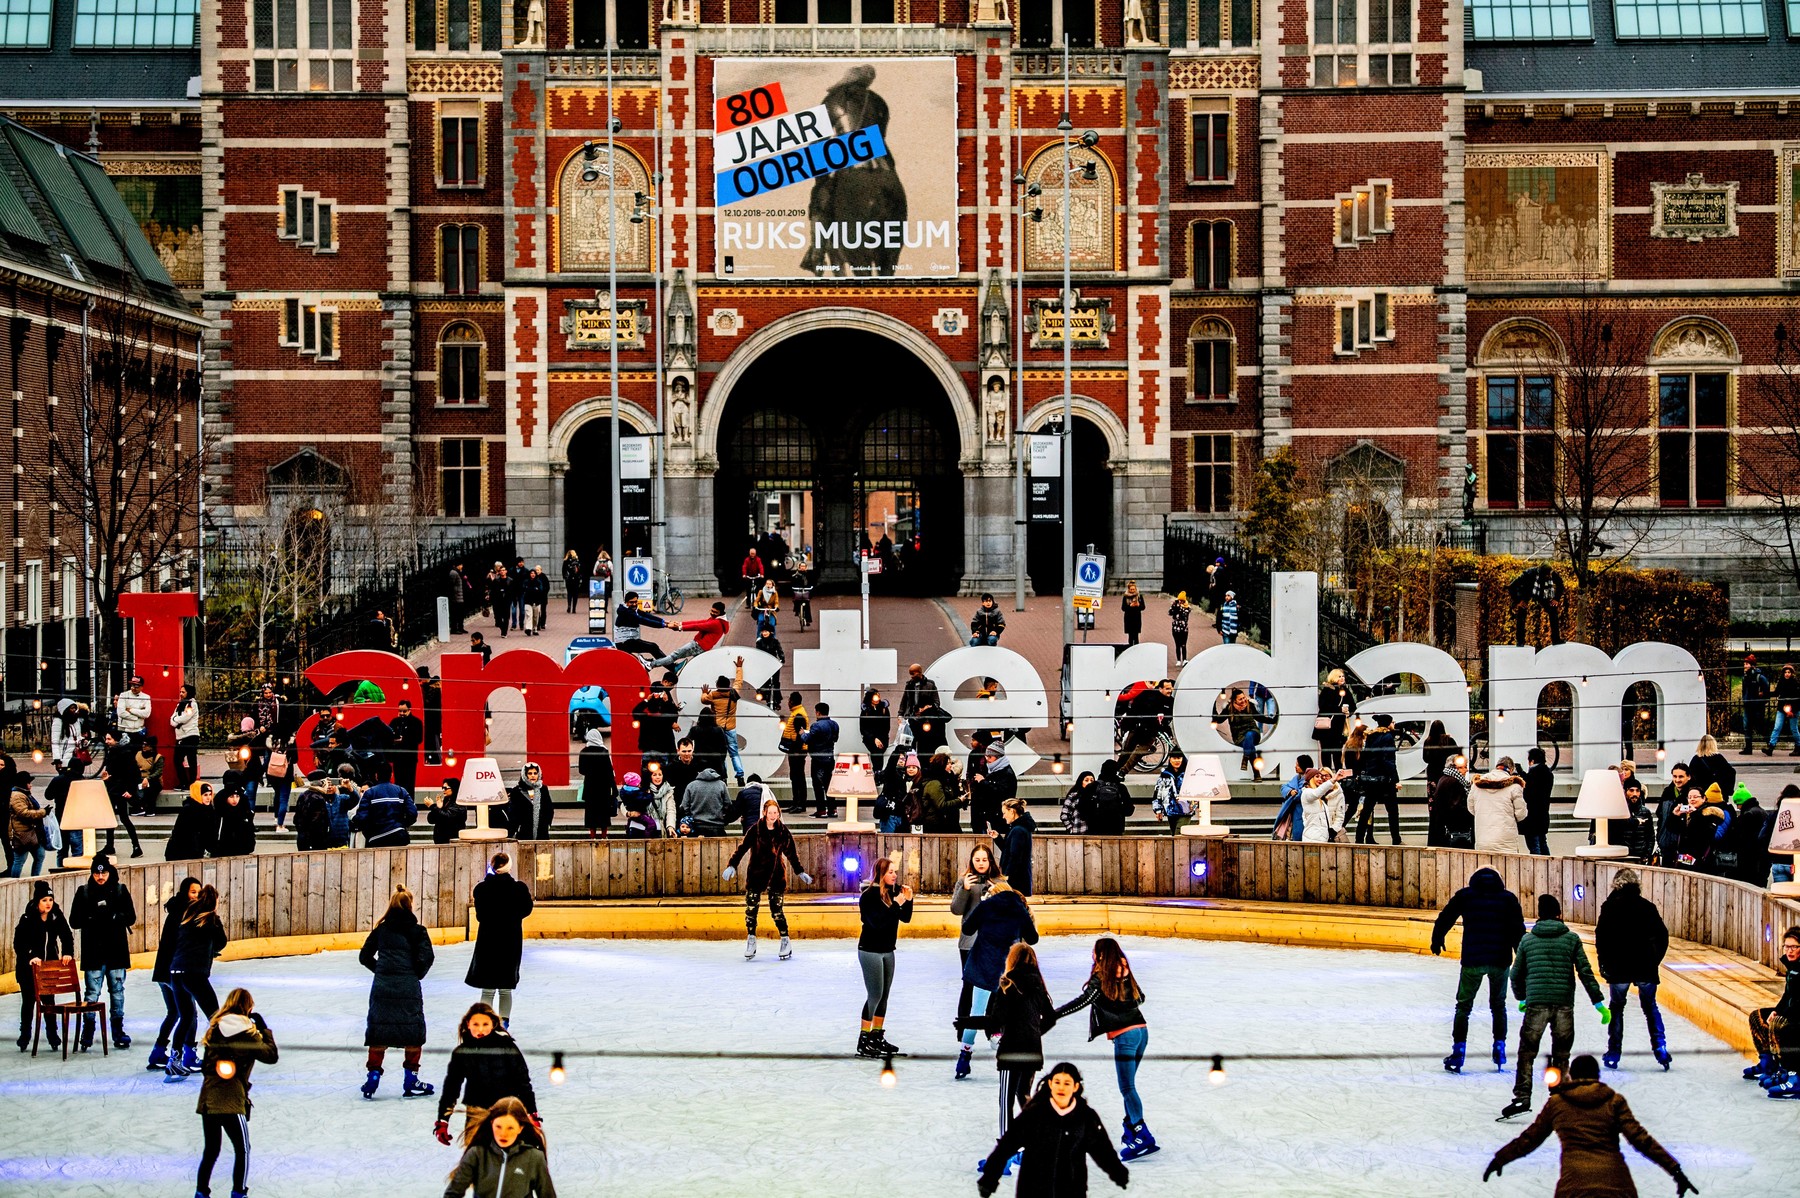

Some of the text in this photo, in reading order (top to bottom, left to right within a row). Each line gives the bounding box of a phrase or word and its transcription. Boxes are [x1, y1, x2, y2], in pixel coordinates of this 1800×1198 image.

[726, 87, 775, 127] 80
[731, 110, 824, 164] JAAR
[732, 129, 875, 198] OORLOG
[814, 220, 951, 249] MUSEUM
[475, 771, 497, 780] DPA
